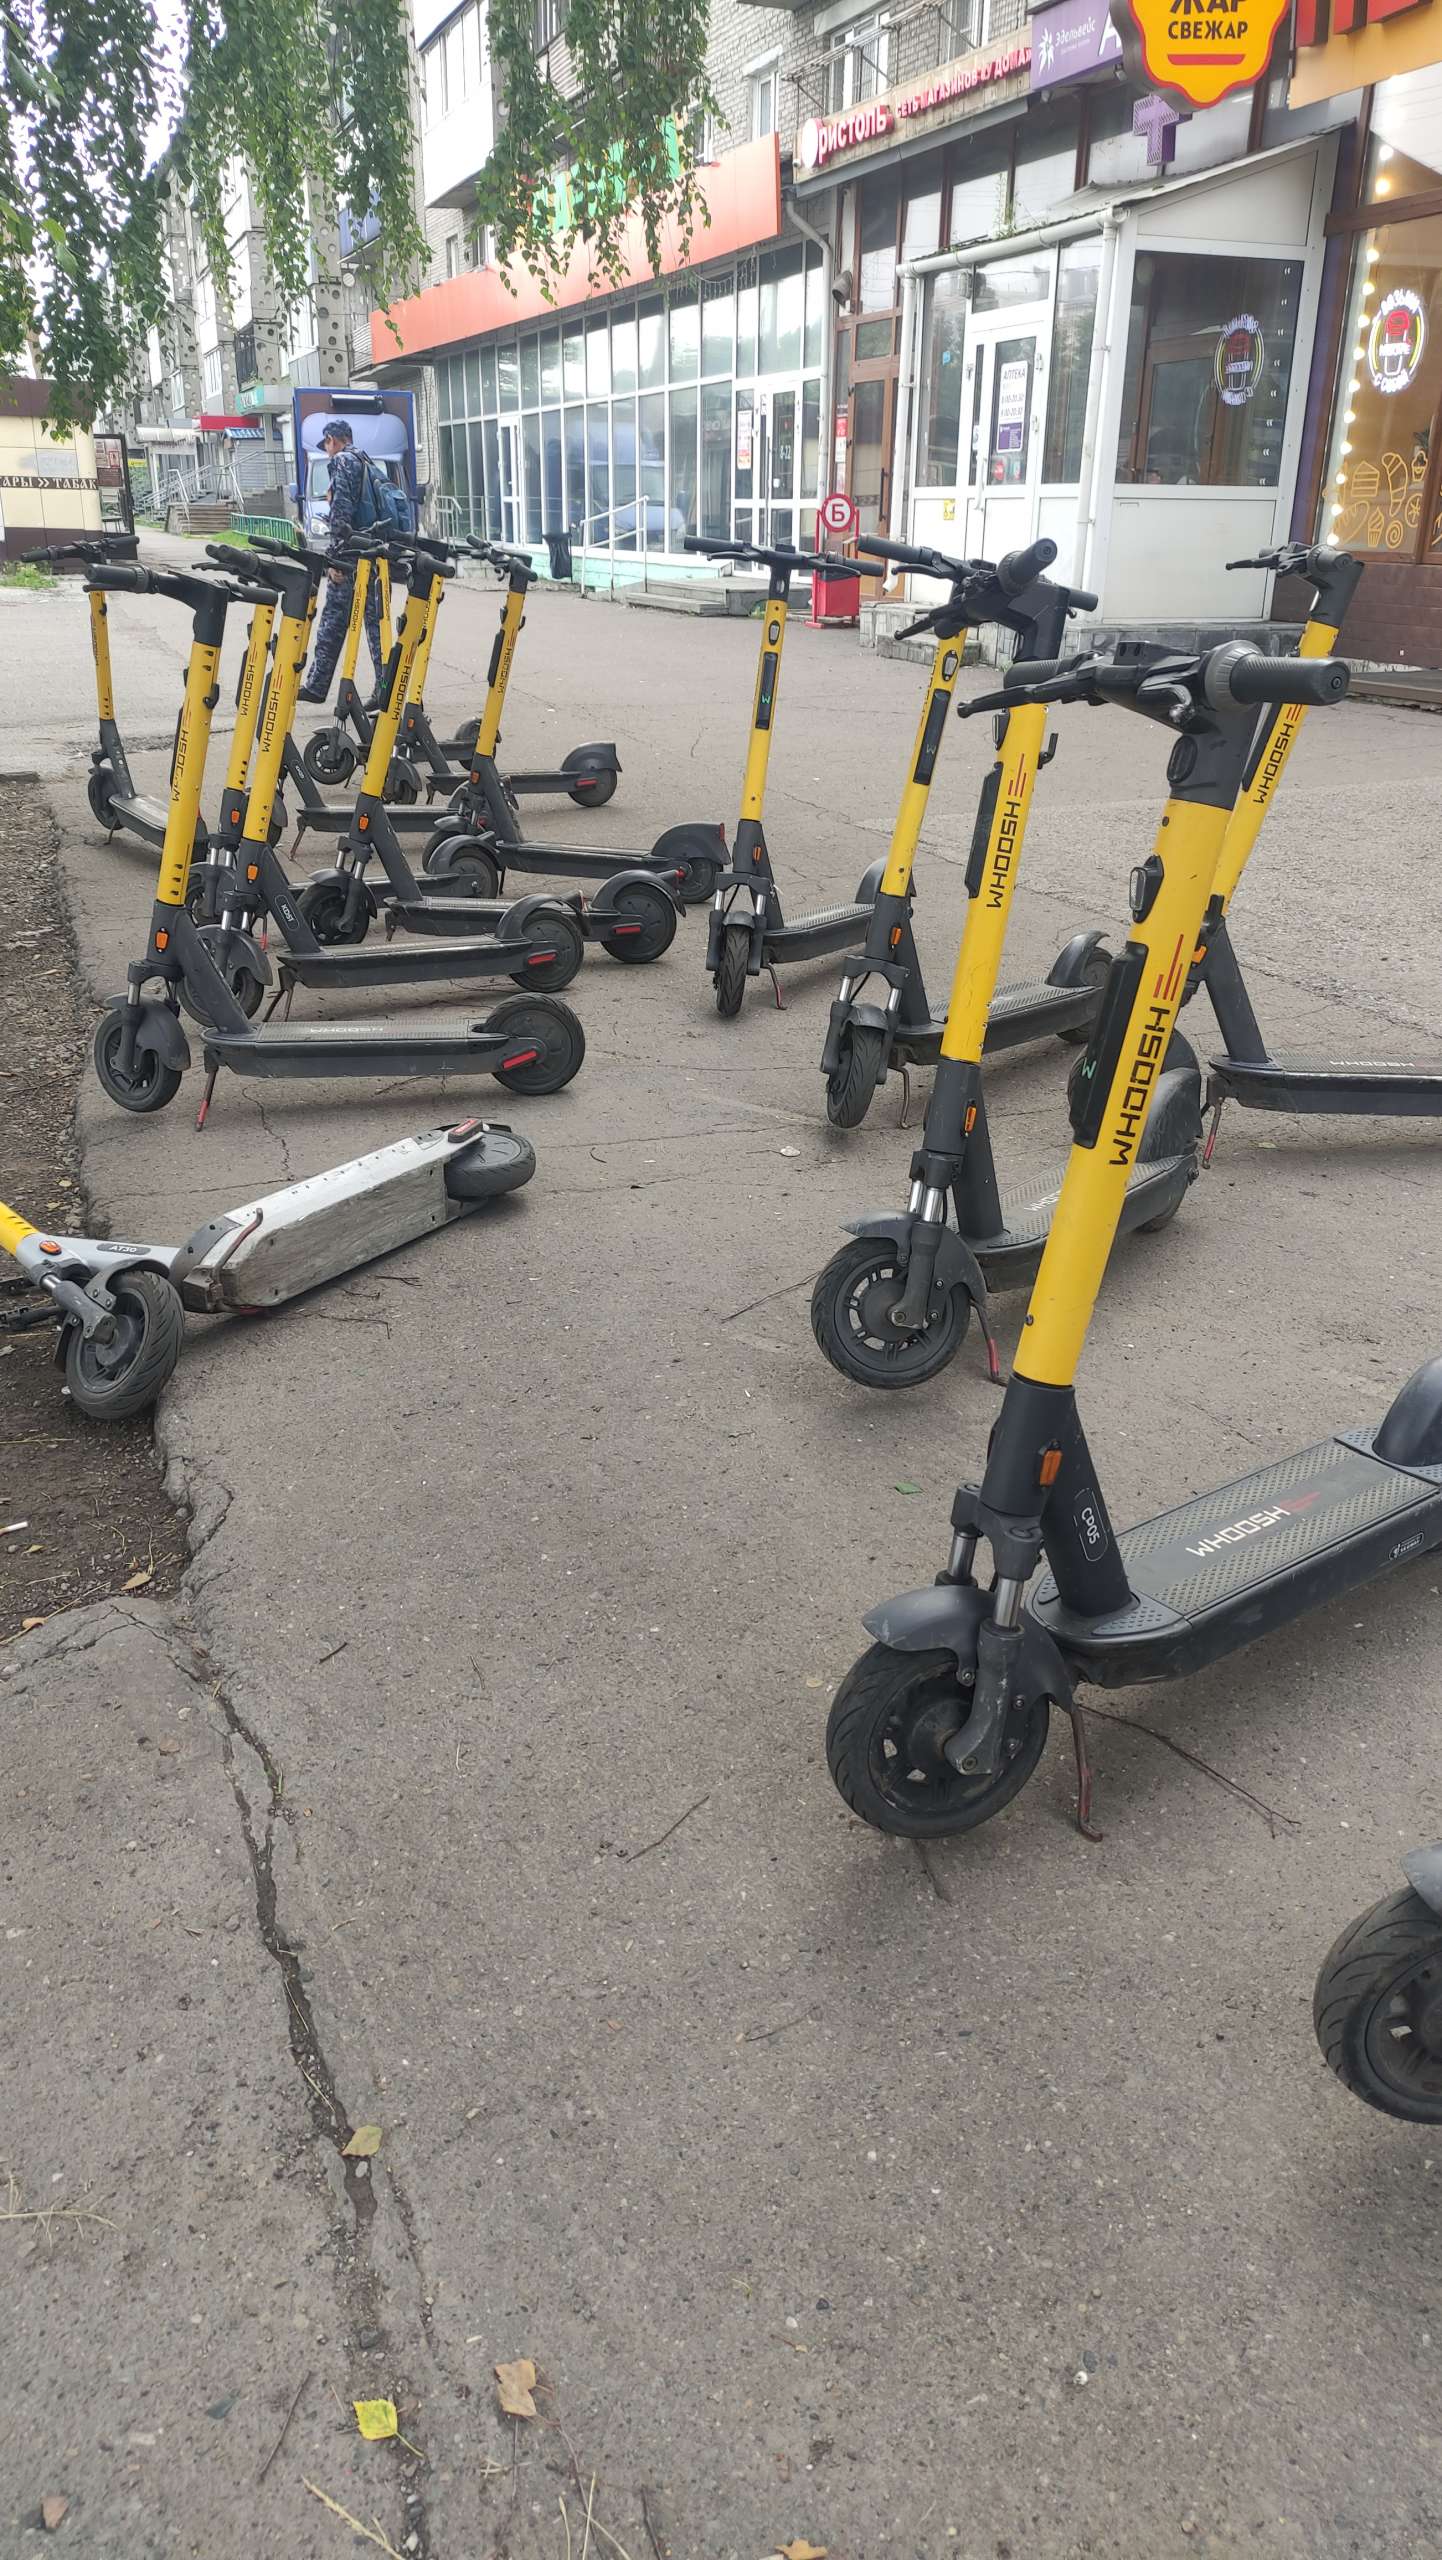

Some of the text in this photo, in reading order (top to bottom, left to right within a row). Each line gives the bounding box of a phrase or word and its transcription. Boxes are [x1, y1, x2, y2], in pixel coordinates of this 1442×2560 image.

[1168, 20, 1248, 41] СВЕЖАР
[920, 71, 978, 109] МАГАЗИНОВ
[1003, 368, 1025, 380] АПТЕКА
[0, 476, 97, 489] АРЫ ТАБАК
[831, 504, 845, 522] Б
[240, 664, 256, 716] WHOOSH
[391, 665, 411, 720] WHOOSH
[261, 691, 281, 753] WHOOSH
[1252, 722, 1295, 804] WHOOSH
[986, 801, 1021, 908] WHOOSH
[1110, 1006, 1172, 1165] WHOOSH
[109, 1245, 137, 1253] AT30
[1185, 1505, 1291, 1558] WHOOSH
